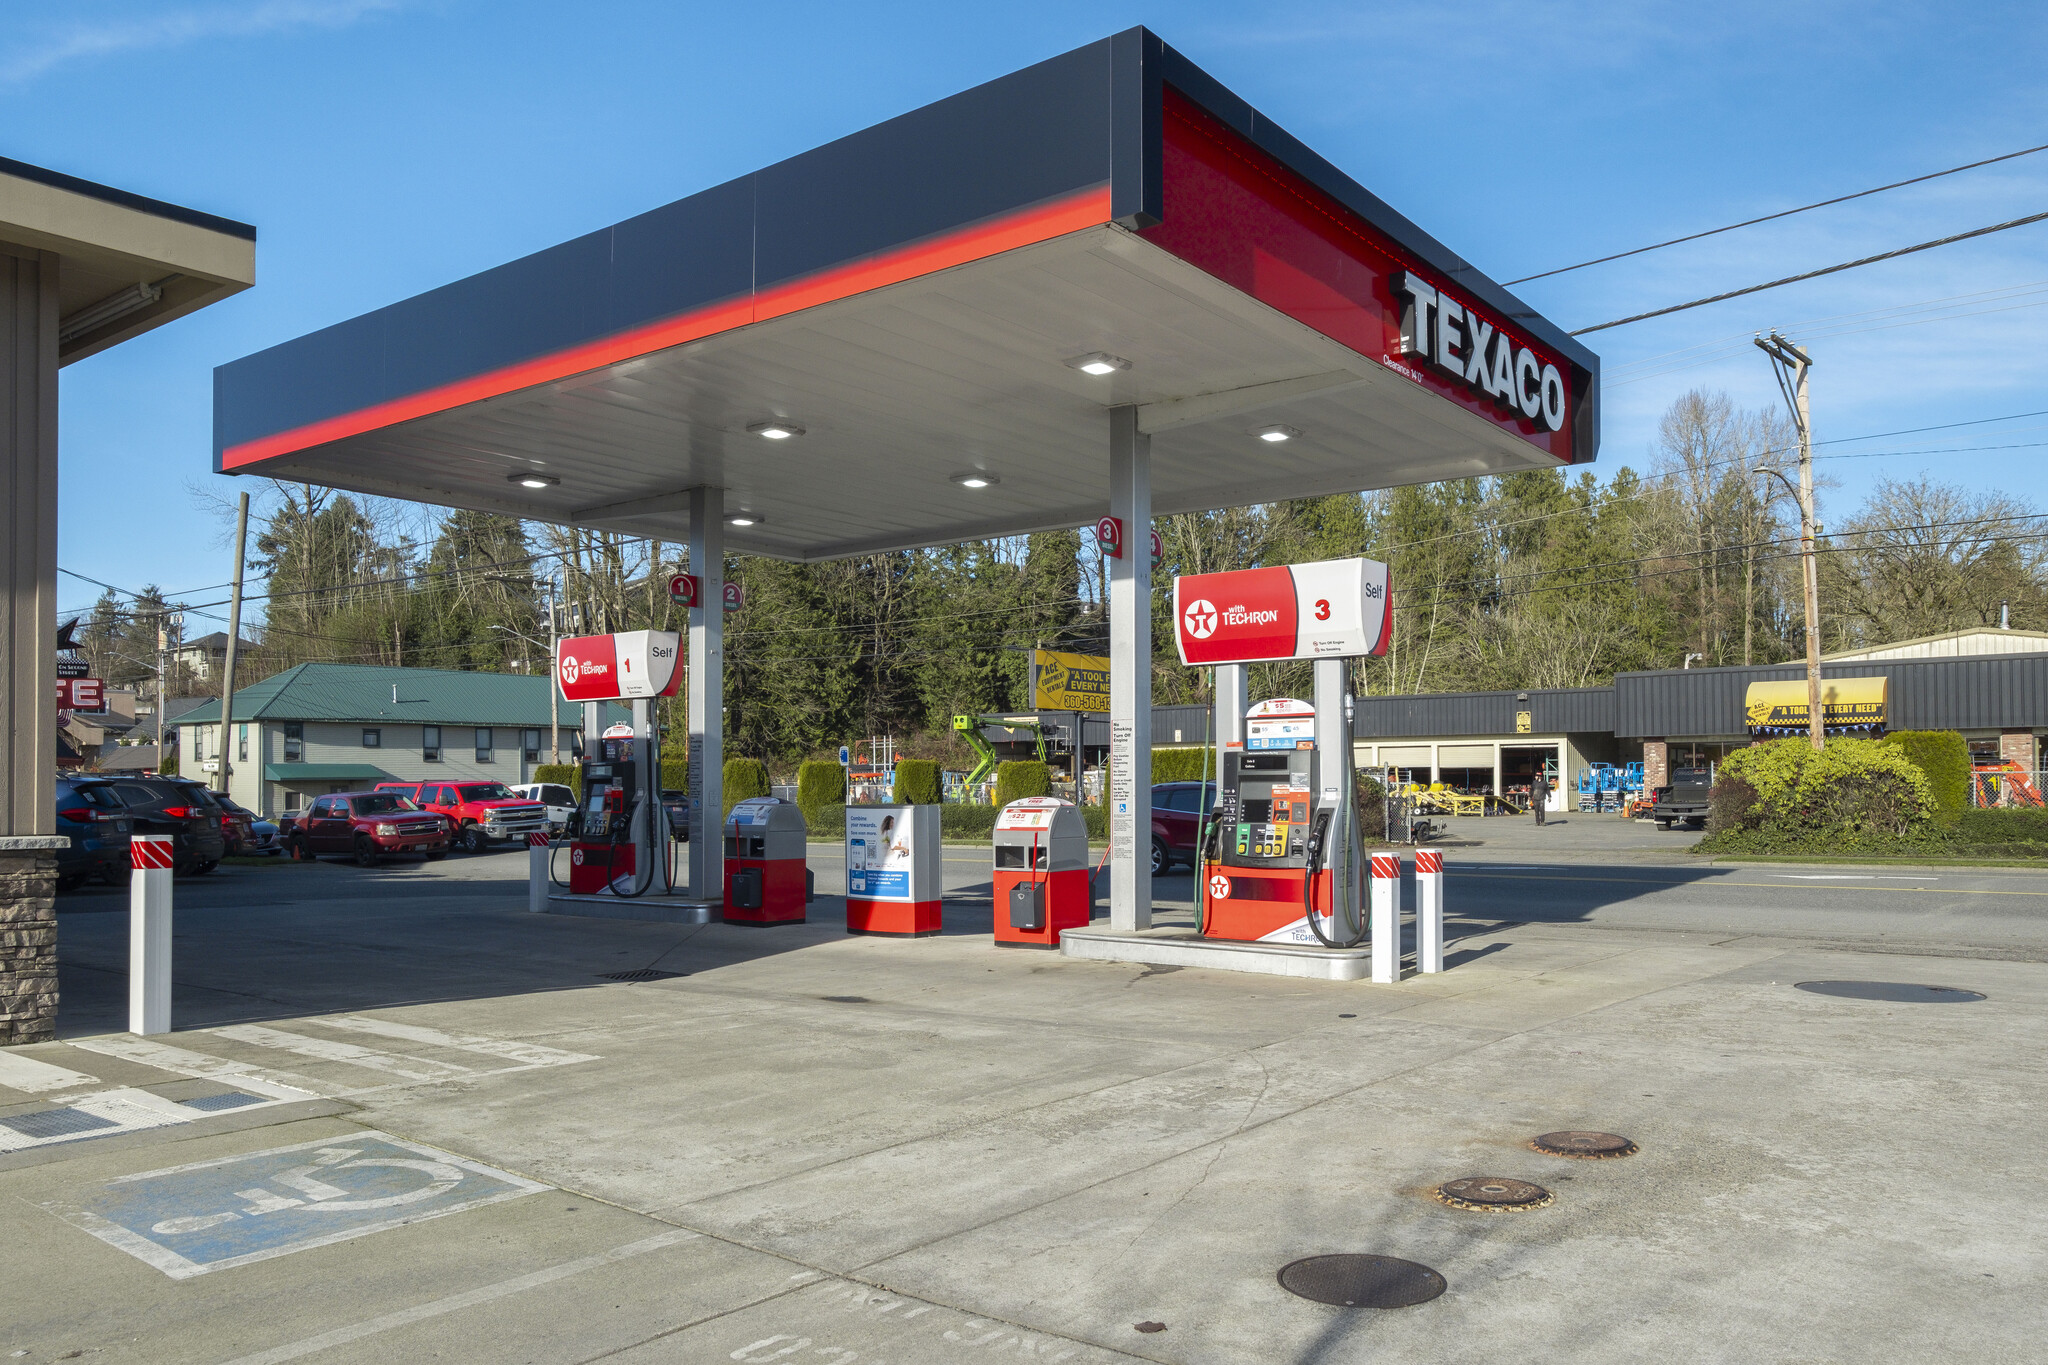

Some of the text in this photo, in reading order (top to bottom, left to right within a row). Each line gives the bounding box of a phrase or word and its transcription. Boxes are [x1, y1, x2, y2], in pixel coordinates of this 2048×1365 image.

[1402, 269, 1566, 432] TEXACO
[1383, 354, 1410, 377] Clearance
[1103, 524, 1112, 540] 3
[677, 580, 684, 593] 1
[1365, 582, 1383, 600] Self
[726, 588, 735, 600] 2
[1228, 604, 1245, 613] with
[1314, 599, 1331, 621] 3
[1222, 610, 1278, 626] TECHRON
[652, 646, 672, 658] Self
[580, 664, 608, 675] TECHRON
[624, 658, 631, 673] 1
[1044, 661, 1059, 676] ACE
[1041, 670, 1065, 687] EQUIPMENT
[1071, 670, 1080, 680] "A
[1082, 671, 1104, 682] TOOL
[1046, 680, 1065, 694] RENTALS
[1071, 680, 1098, 691] EVERY
[1776, 706, 1788, 715] "A
[1789, 706, 1809, 715] TOOL
[1829, 703, 1854, 714] EVERY
[1855, 703, 1882, 713] NEED"
